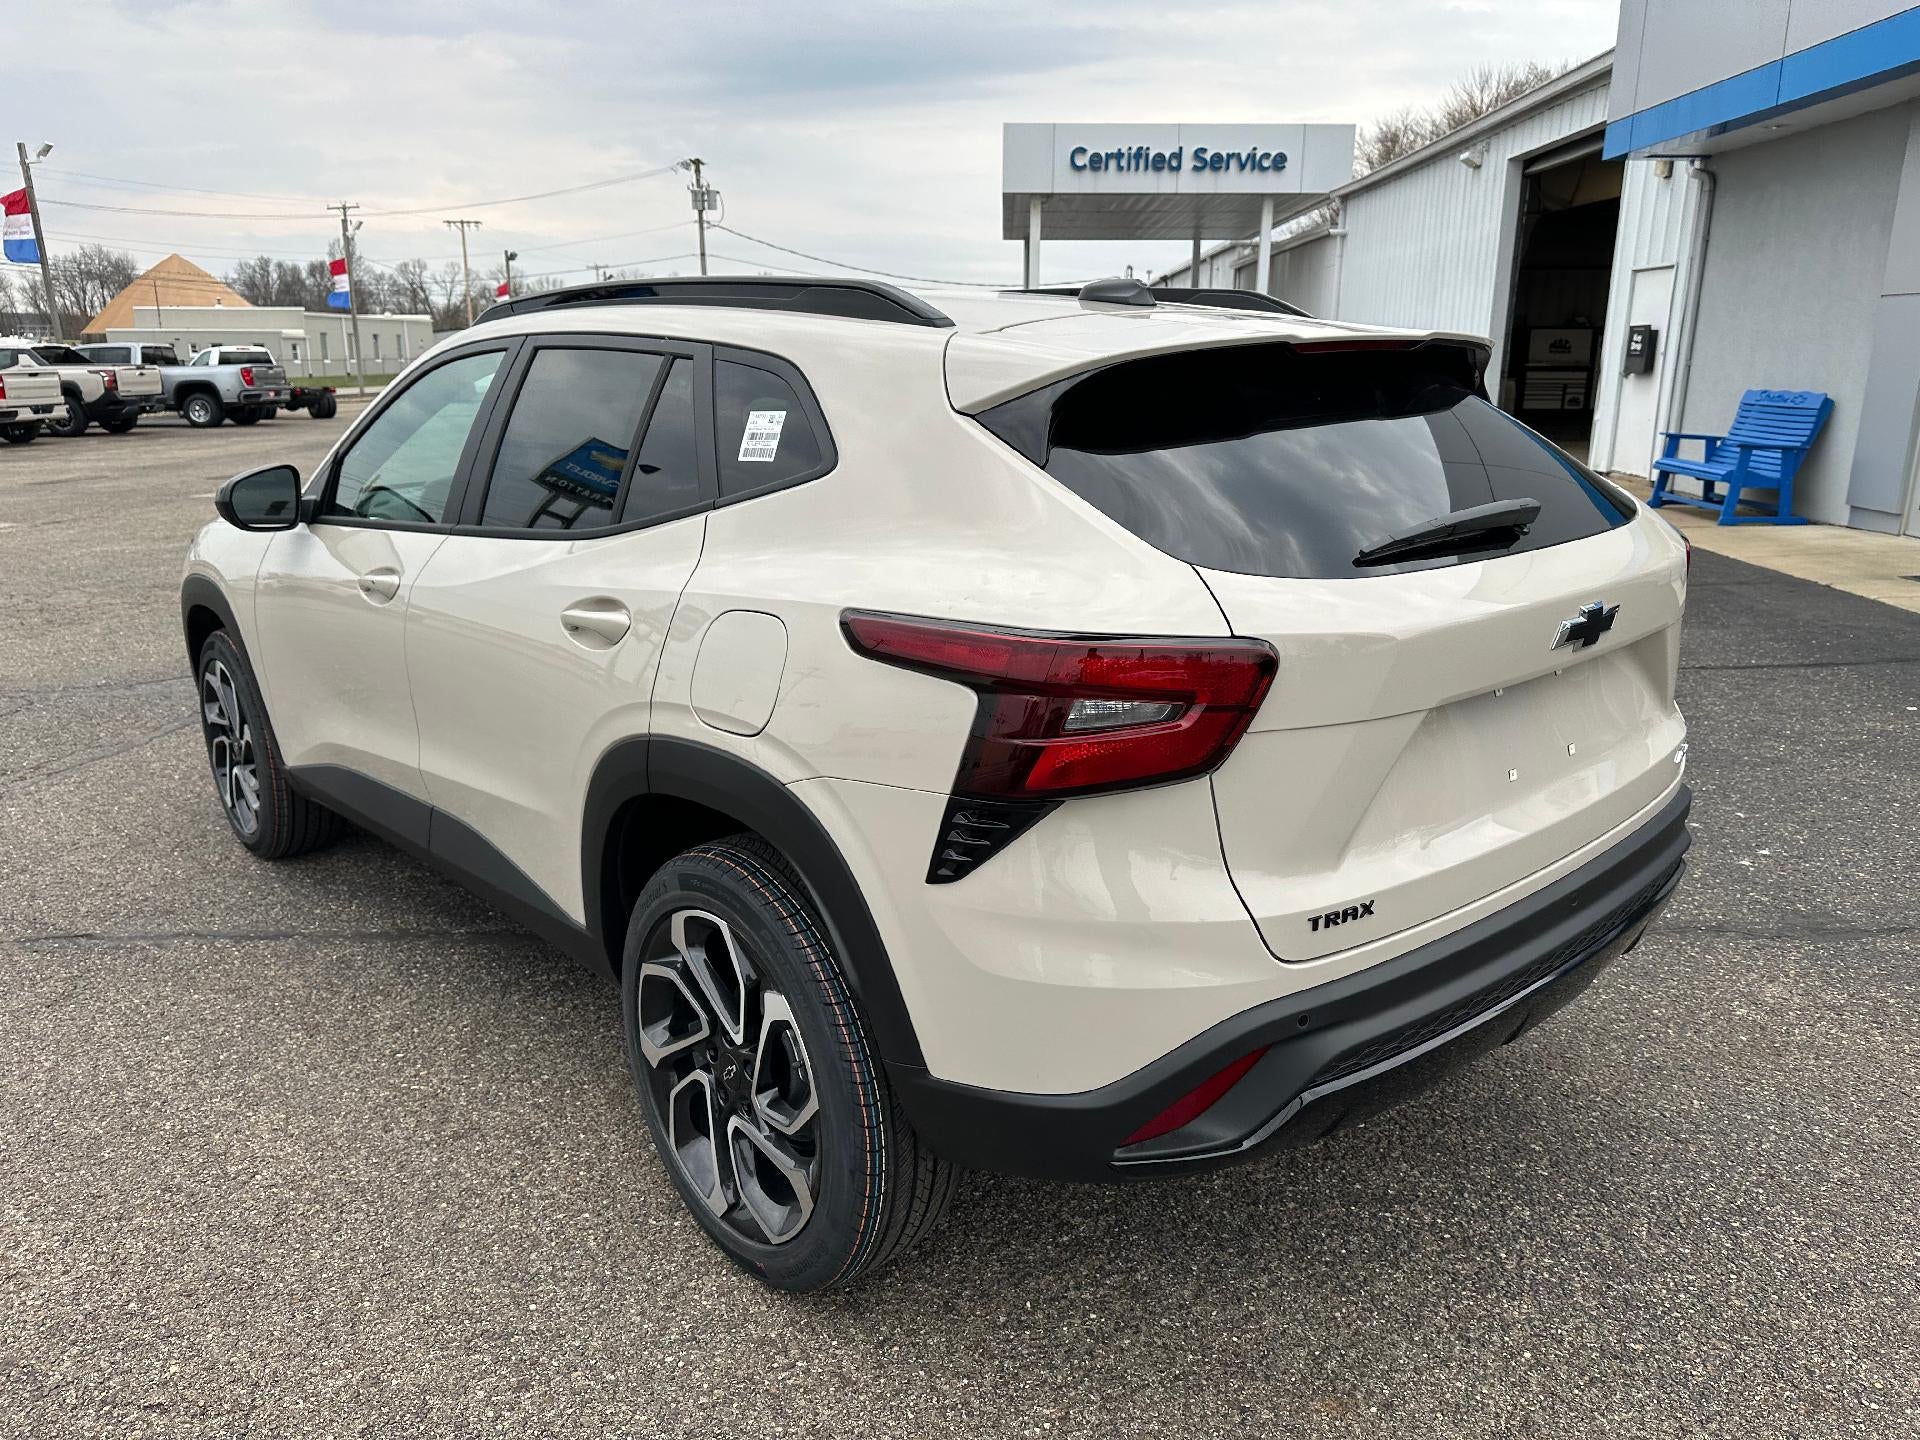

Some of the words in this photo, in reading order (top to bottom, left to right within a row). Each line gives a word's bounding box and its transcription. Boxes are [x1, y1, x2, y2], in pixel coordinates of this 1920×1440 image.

[1070, 146, 1183, 171] Certified
[1191, 146, 1288, 171] Service
[1307, 899, 1375, 932] TRAX
